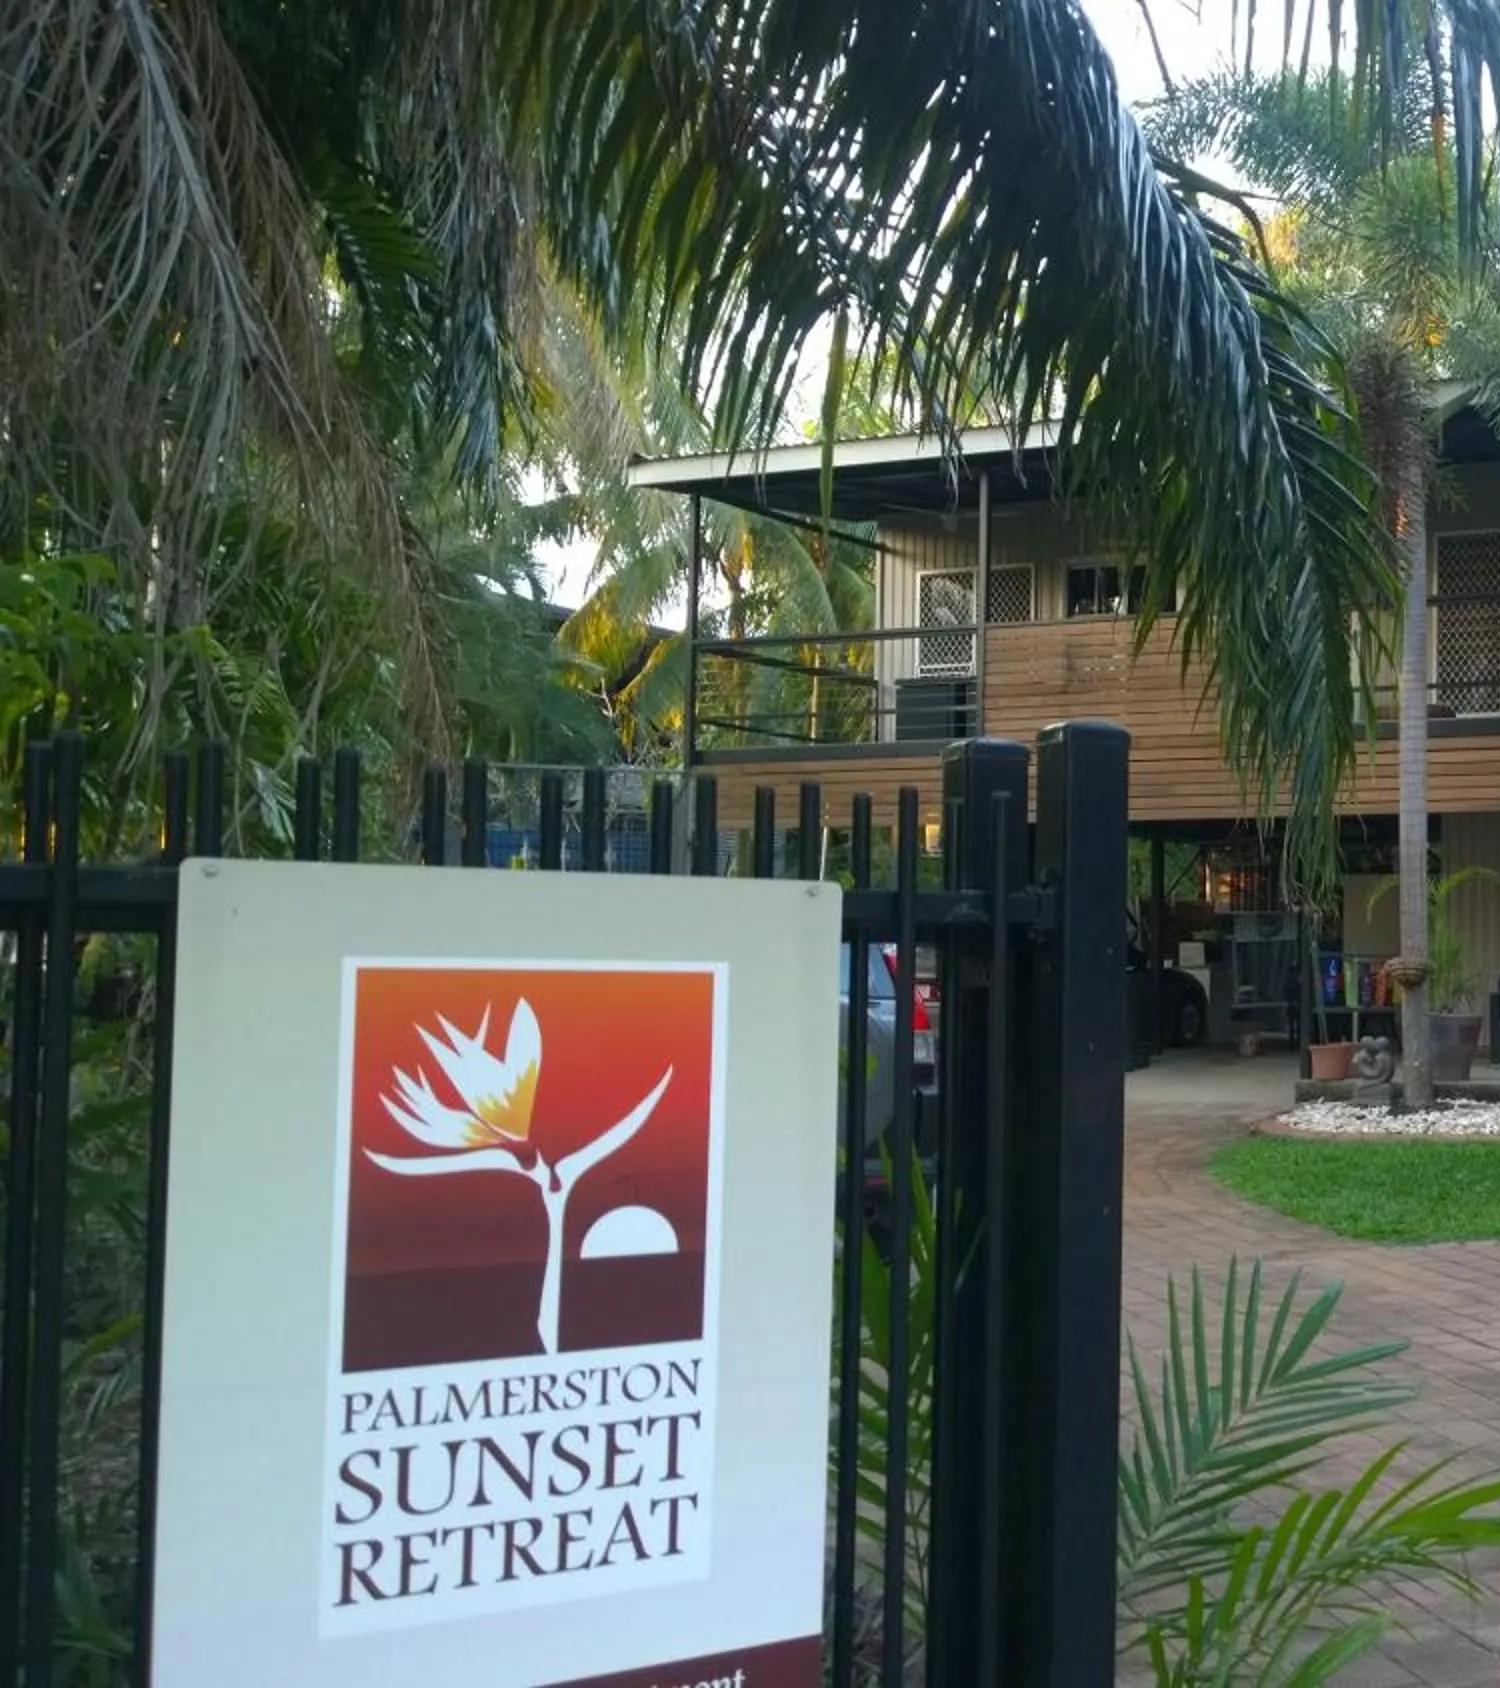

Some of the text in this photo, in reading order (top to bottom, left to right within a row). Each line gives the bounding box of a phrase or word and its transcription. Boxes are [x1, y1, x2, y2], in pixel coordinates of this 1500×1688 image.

[341, 1358, 703, 1435] PALMERSTON
[335, 1411, 702, 1525] SUNSET
[332, 1494, 699, 1607] RETREAT
